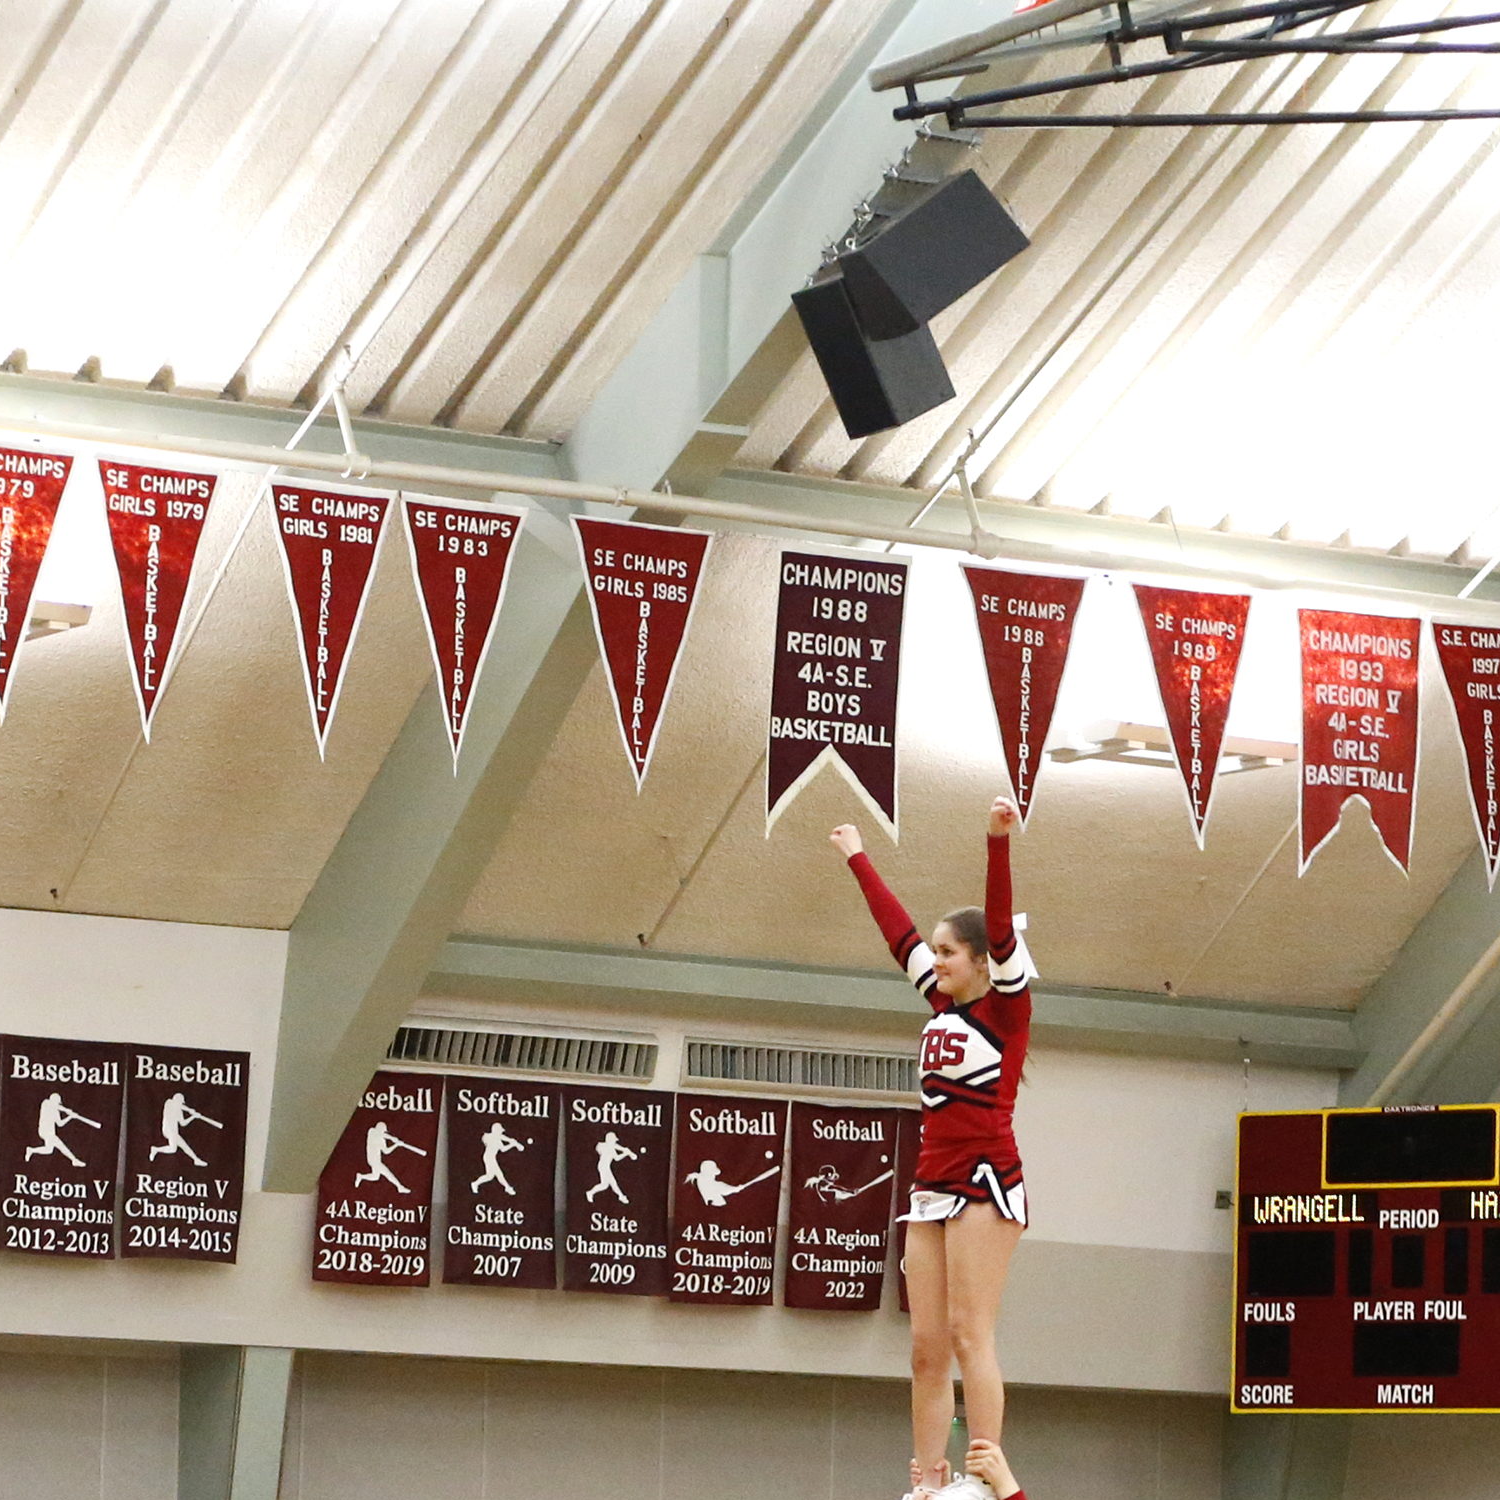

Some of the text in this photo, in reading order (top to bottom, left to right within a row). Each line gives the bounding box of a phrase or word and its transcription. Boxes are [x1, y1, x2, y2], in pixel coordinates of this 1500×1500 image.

[280, 494, 380, 522] SE CHAMPS
[283, 518, 372, 544] GIRLS 1981
[416, 511, 511, 538] SE CHAMPS
[439, 535, 487, 556] 1983
[594, 549, 687, 578] SE CHAMPS
[595, 575, 687, 602] GIRLS 1985
[783, 564, 902, 595] CHAMPIONS
[813, 597, 867, 622] 1988
[981, 595, 1065, 621] SE CHAMPS
[317, 548, 332, 712] BASKETBALL
[1005, 626, 1043, 646] 1988
[1442, 630, 1464, 646] S.E.
[452, 567, 466, 735] BASKETBALL
[787, 631, 886, 661] REGION V
[1309, 630, 1411, 659] CHAMPIONS
[798, 662, 871, 688] 4A-S.E.
[1339, 662, 1383, 682] 1993
[1473, 658, 1500, 674] 1997
[631, 601, 651, 763] BASKETBALL
[807, 691, 860, 716] BOYS
[1316, 684, 1401, 713] REGION V
[771, 717, 891, 748] BASKETBALL
[1017, 648, 1032, 806] BASKETBALL
[1484, 710, 1497, 860] BASKETBALL
[135, 1055, 240, 1086] Baseball
[458, 1089, 548, 1117] Softball
[690, 1109, 776, 1135] Softball
[813, 1119, 884, 1141] Softball
[125, 1198, 237, 1224] Champions
[475, 1204, 523, 1224] State
[1254, 1195, 1364, 1224] WRANGELL
[1380, 1209, 1438, 1228] PERIOD
[129, 1226, 231, 1253] 2014-2015
[448, 1226, 553, 1251] Champions
[474, 1255, 521, 1277] 2007
[676, 1248, 772, 1271] Champions
[673, 1273, 770, 1295] 2018-2019
[826, 1282, 864, 1298] 2022
[1245, 1303, 1295, 1321] FOULS
[1354, 1301, 1466, 1320] PLAYER FOUL
[1242, 1385, 1293, 1403] SCORE
[1378, 1385, 1433, 1403] MATCH
